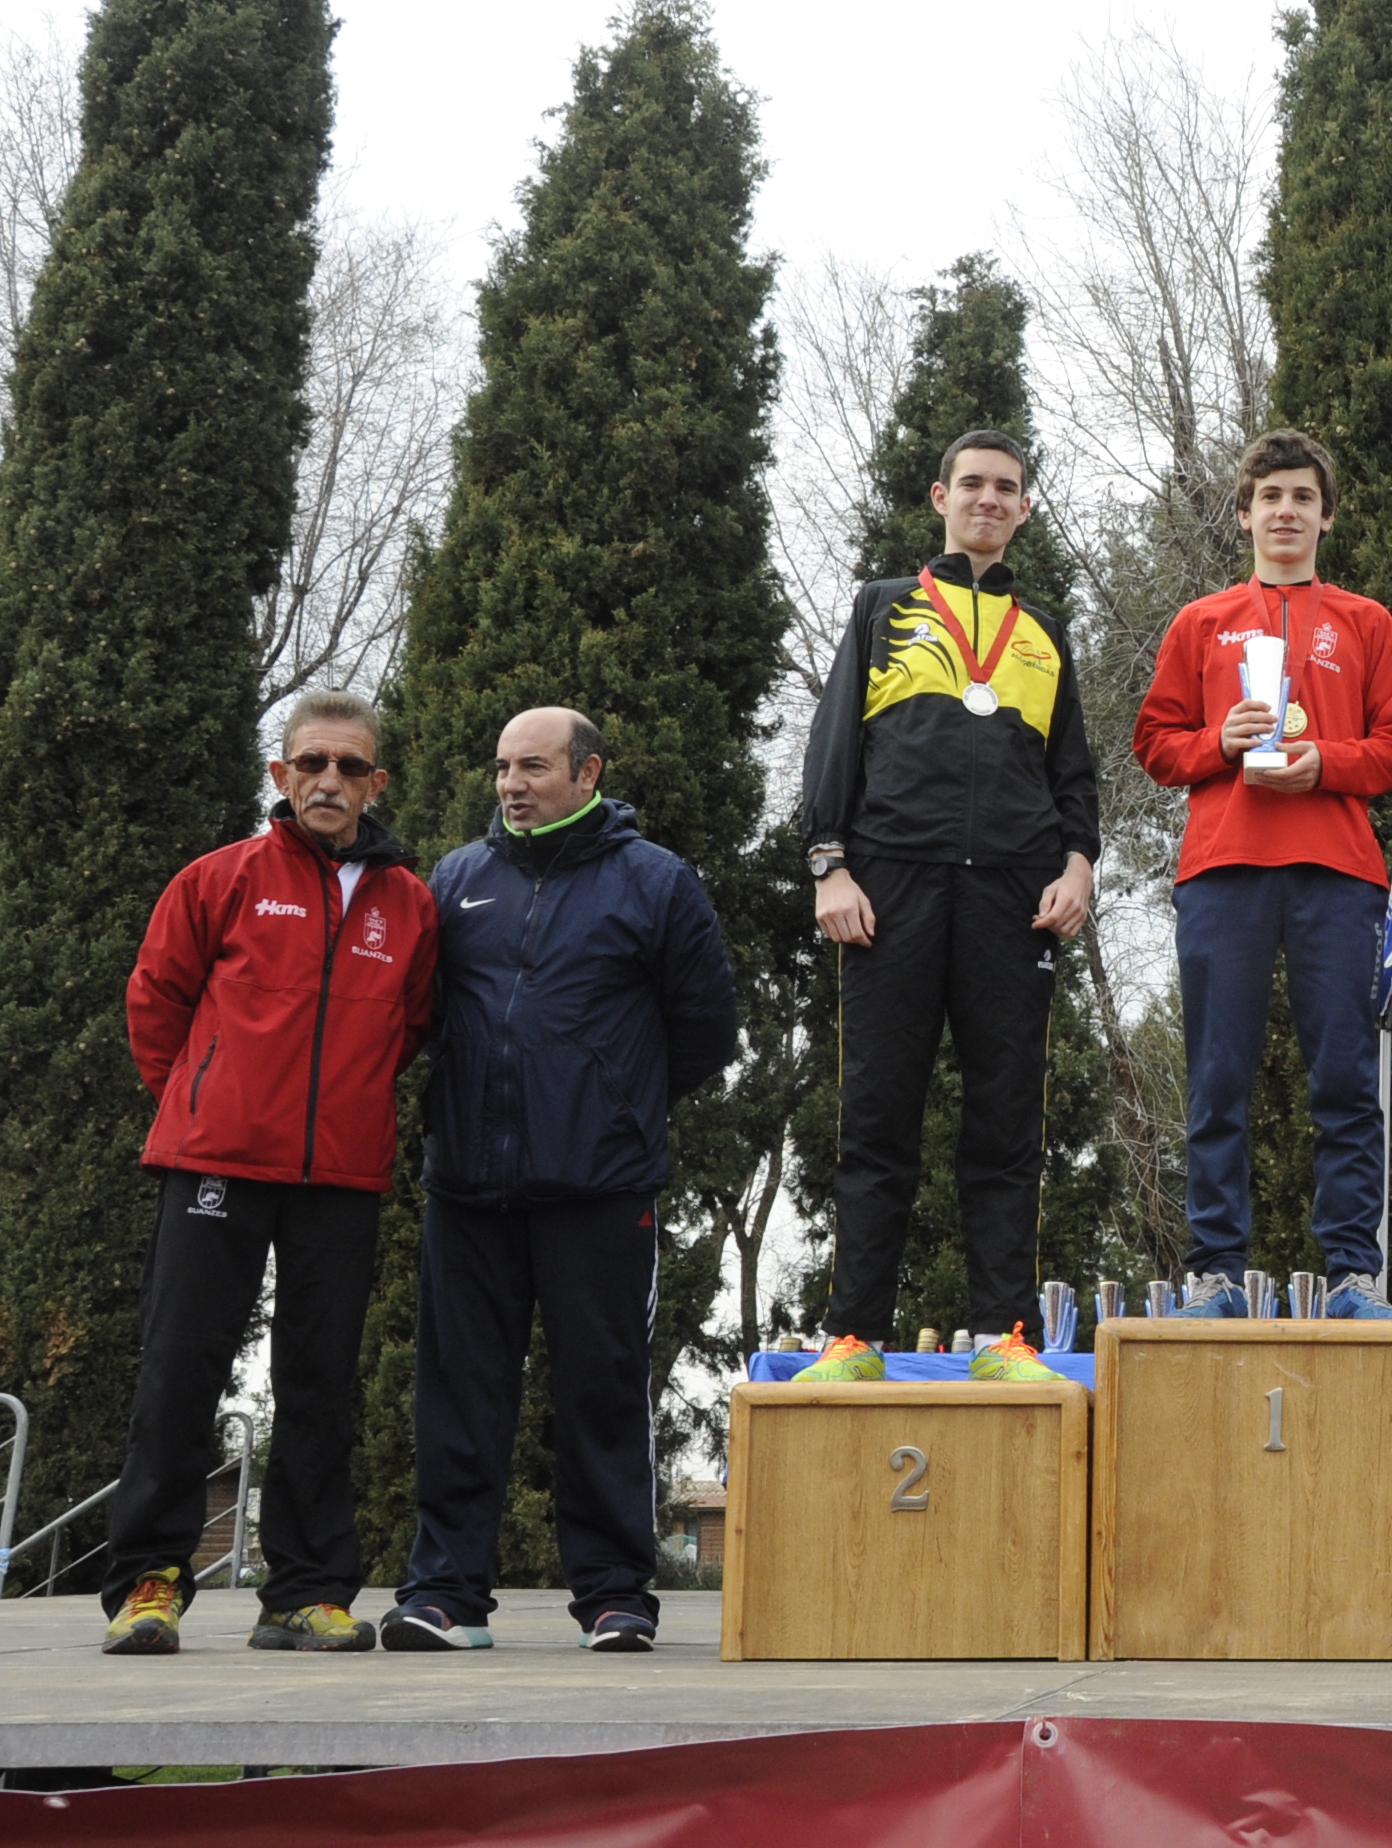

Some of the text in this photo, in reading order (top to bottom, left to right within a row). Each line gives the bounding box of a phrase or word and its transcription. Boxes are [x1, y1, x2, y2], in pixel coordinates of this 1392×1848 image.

[351, 945, 393, 963] SUANZES
[1263, 1386, 1287, 1453] 1
[889, 1445, 930, 1514] 2
